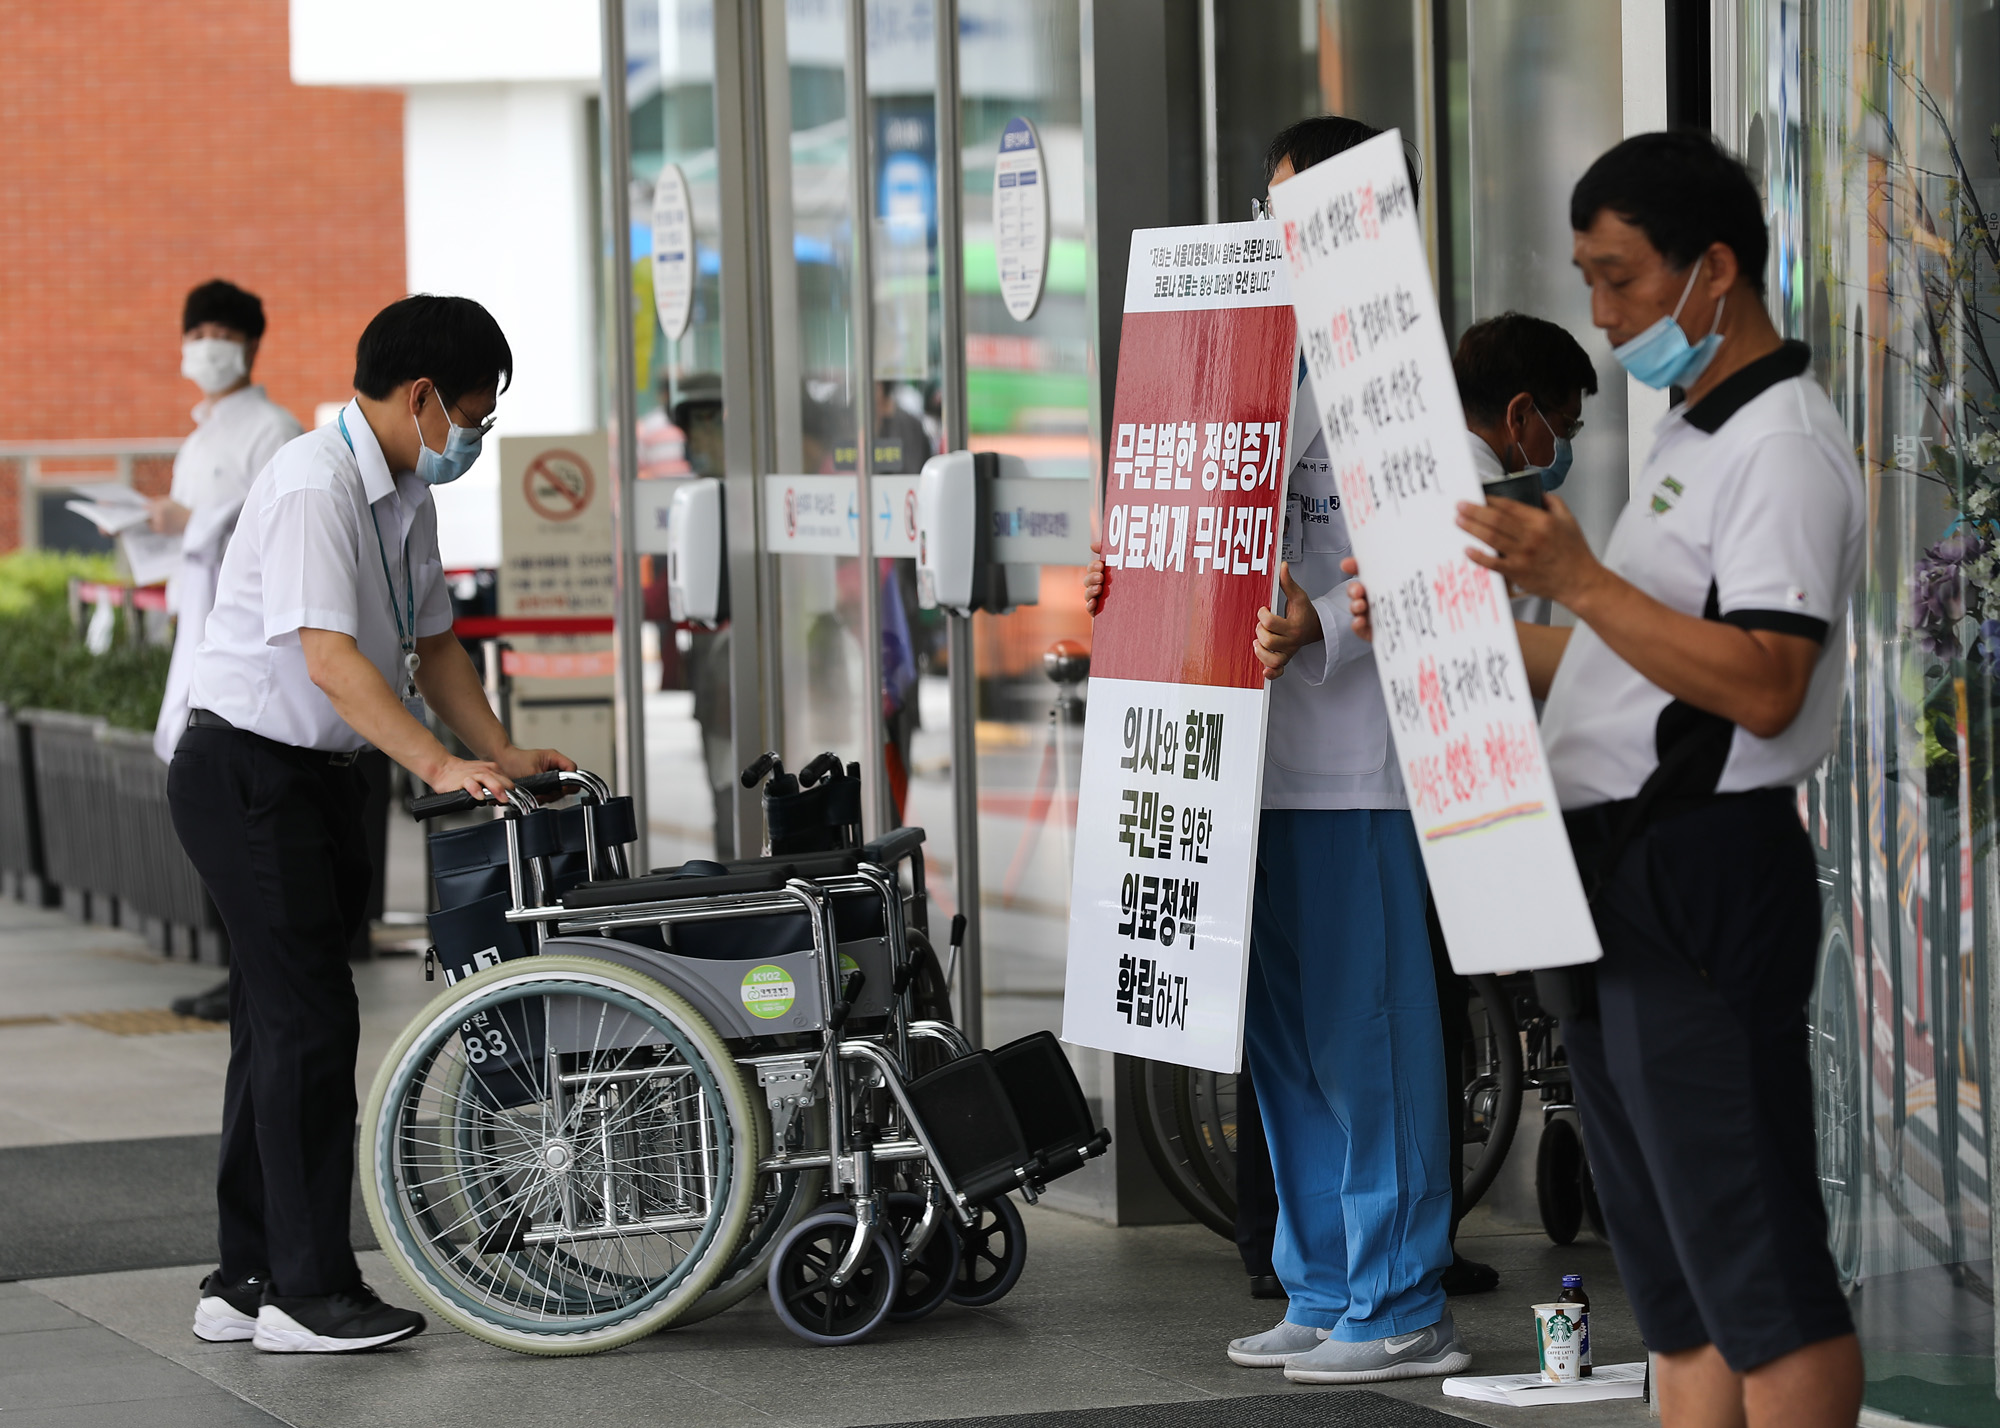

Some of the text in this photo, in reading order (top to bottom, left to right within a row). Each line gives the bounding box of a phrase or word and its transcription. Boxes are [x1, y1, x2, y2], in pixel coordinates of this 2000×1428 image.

[1154, 274, 1176, 298] 코로나
[1177, 274, 1198, 298] 진료는
[1199, 274, 1213, 296] 항상
[1213, 273, 1234, 295] 파업에
[1235, 270, 1249, 294] 우선
[1173, 242, 1221, 267] 서울대병원에서
[1222, 242, 1241, 264] 일하는
[1243, 239, 1265, 263] 전문의
[1113, 420, 1281, 492] 무분별한 정원증가
[1105, 502, 1274, 576] 의료체계 무너진다
[1120, 706, 1224, 782] 의사와 함께
[1118, 788, 1213, 865] 국민을 위한
[1118, 871, 1200, 951] 의료정책
[752, 970, 781, 983] K102
[1116, 953, 1189, 1032] 확립하자
[465, 1029, 507, 1063] 83
